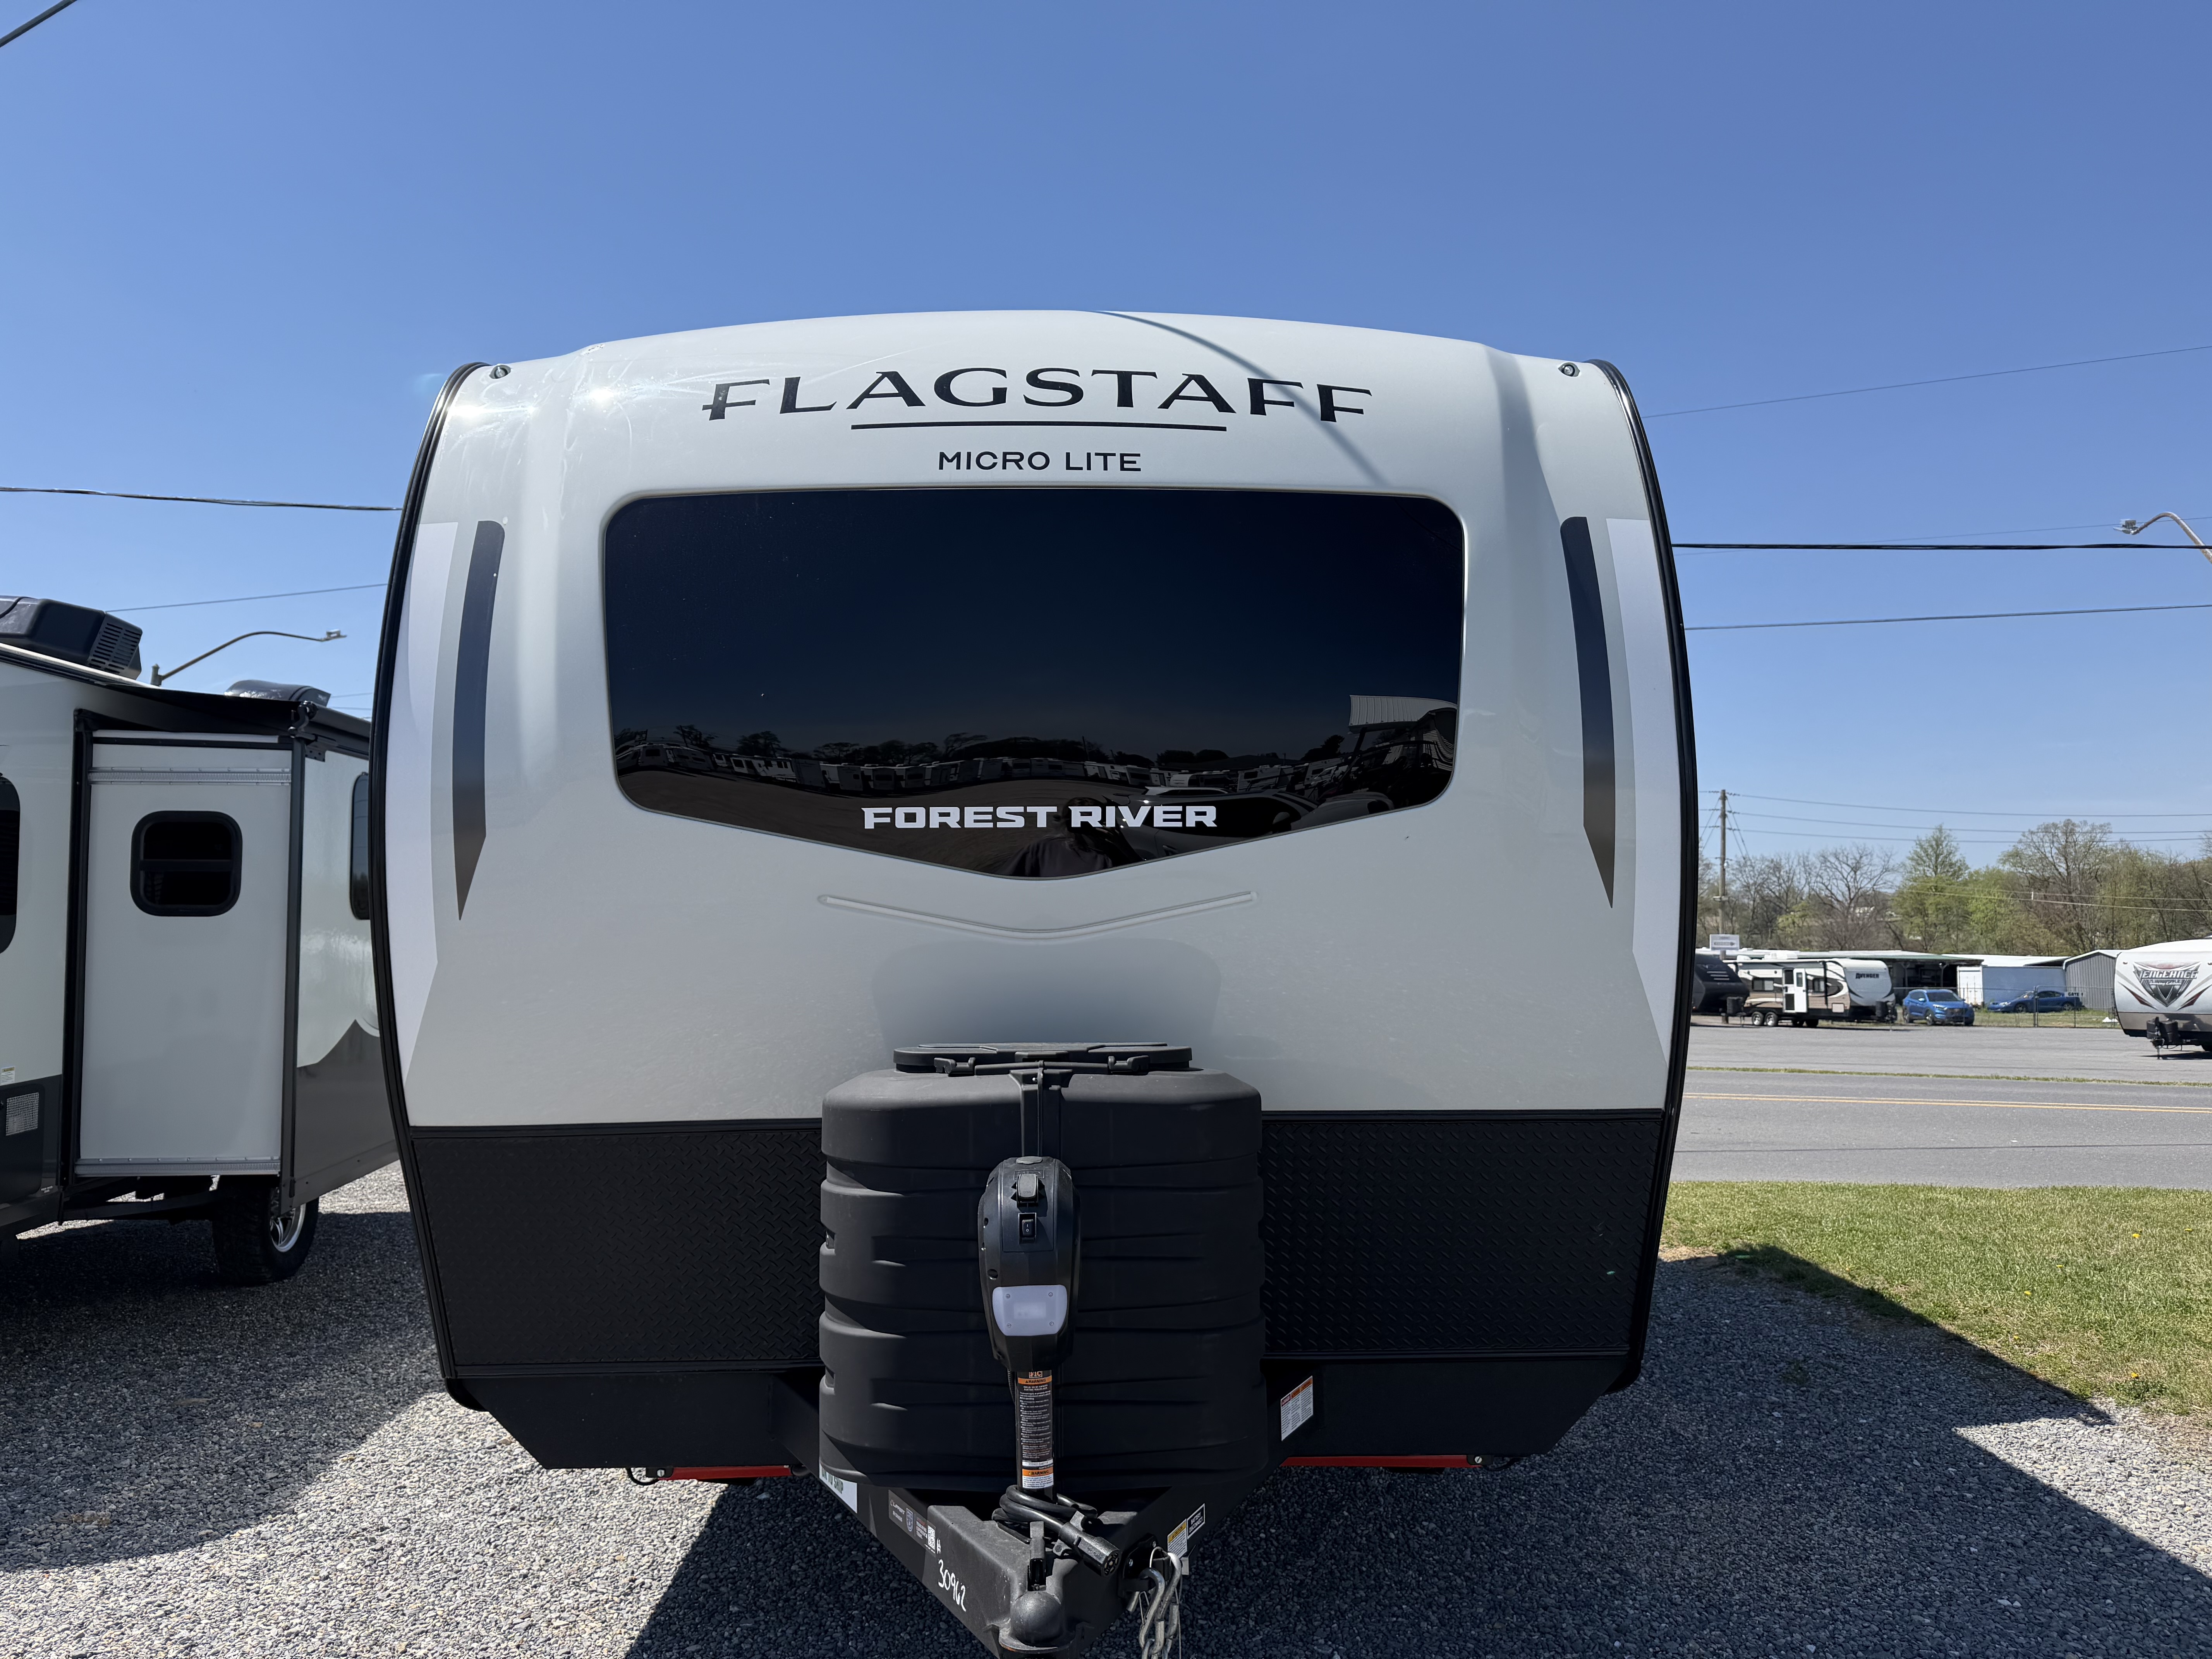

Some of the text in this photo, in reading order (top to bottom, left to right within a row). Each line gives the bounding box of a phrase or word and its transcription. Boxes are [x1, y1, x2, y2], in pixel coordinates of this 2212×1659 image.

[702, 367, 1373, 422] FLAGSTAFF
[939, 451, 1141, 472] MICRO LITE
[861, 806, 1217, 829] FOREST RIVER
